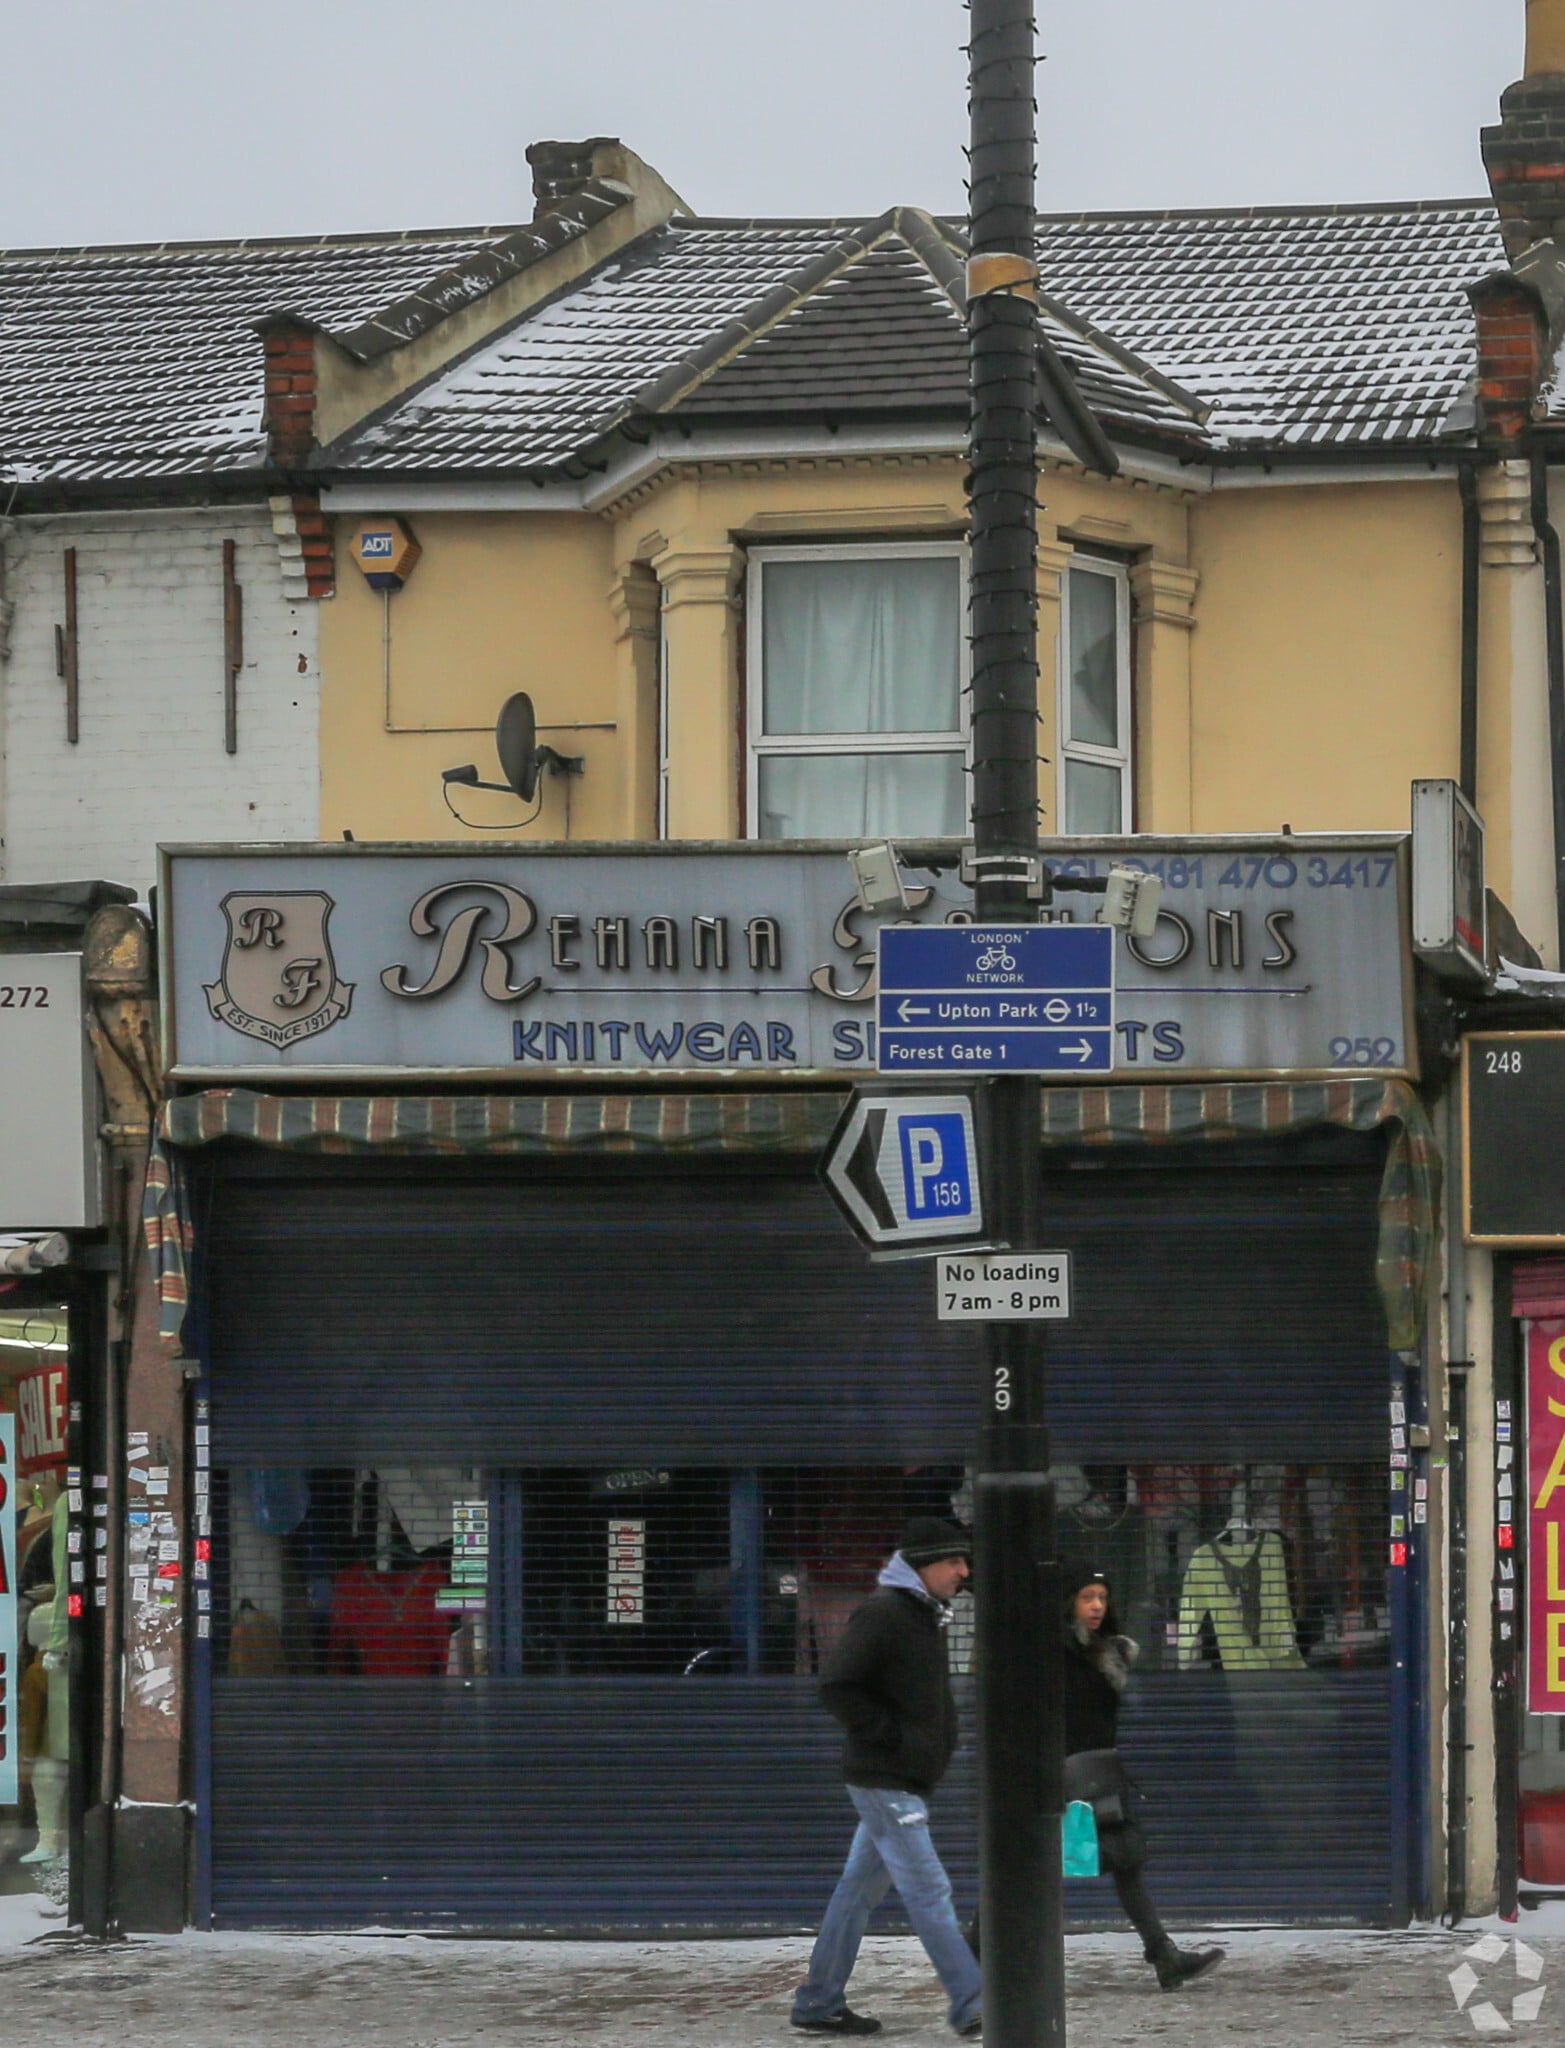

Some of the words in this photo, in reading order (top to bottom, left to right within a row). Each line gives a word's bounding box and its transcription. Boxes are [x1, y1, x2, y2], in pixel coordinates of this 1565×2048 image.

[361, 537, 393, 552] ADT
[1219, 856, 1298, 889] 470
[1307, 857, 1394, 889] 3417
[379, 879, 782, 1002] REHANA
[970, 933, 1023, 944] LONDON
[966, 973, 1025, 984] NETWORK
[0, 986, 50, 1008] 272
[938, 1003, 991, 1020] Upton
[999, 1002, 1039, 1018] Park
[259, 1025, 301, 1042] SINCE
[304, 1008, 332, 1034] 1977
[512, 1019, 797, 1062] KNITWEAR
[889, 1044, 944, 1060] Forest
[951, 1044, 993, 1060] Gate
[999, 1044, 1007, 1060] 1
[1327, 1037, 1396, 1068] 252
[1486, 1051, 1522, 1074] 248
[908, 1127, 944, 1209] P
[932, 1182, 961, 1207] 158
[945, 1264, 975, 1282] No
[983, 1263, 1060, 1284] loading
[19, 1372, 65, 1460] SALE
